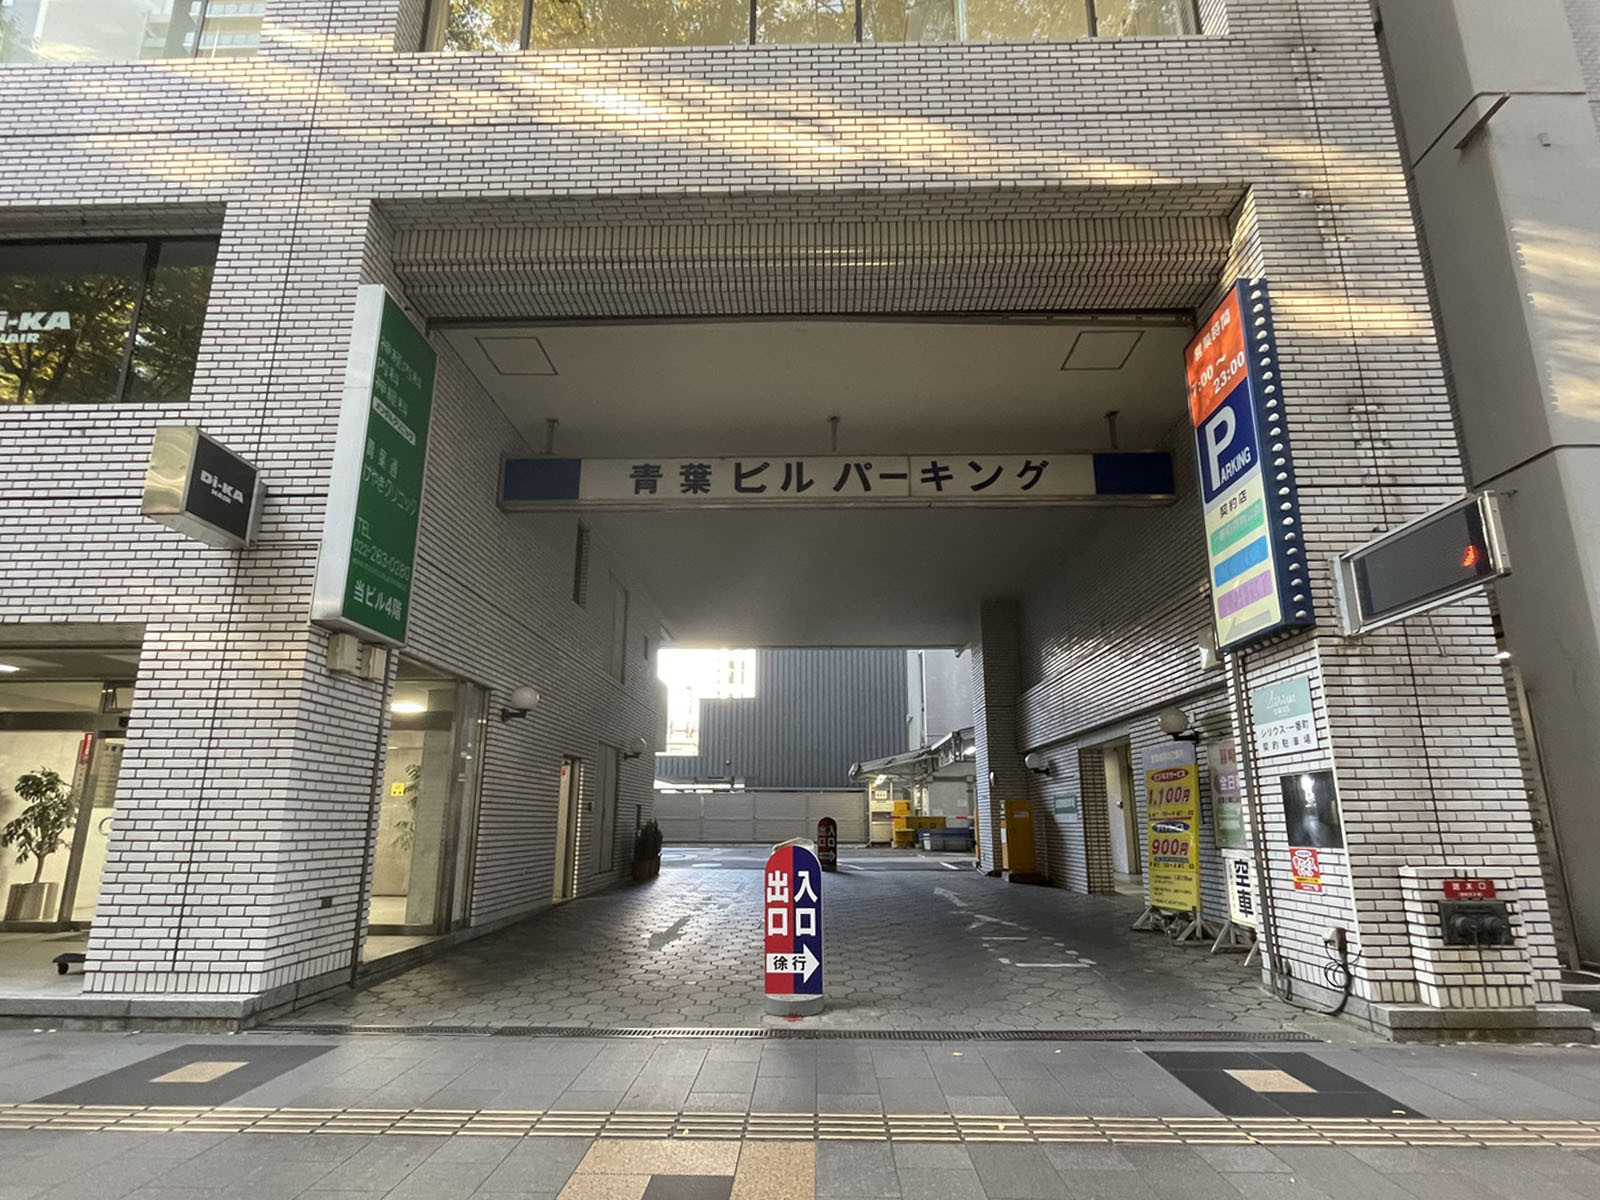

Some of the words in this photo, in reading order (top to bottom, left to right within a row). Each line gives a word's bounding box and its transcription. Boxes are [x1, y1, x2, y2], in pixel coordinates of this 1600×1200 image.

[1213, 351, 1245, 394] 23:00
[200, 470, 244, 504] Di-KA
[629, 460, 1049, 495] 青葉ビルパーキング
[357, 516, 372, 540] TEL
[353, 579, 403, 622] 当ビル4階
[1152, 838, 1188, 856] 900円
[766, 870, 789, 936] 出口
[794, 871, 818, 936] 入口
[1234, 859, 1254, 917] 空車
[773, 956, 807, 971] 徐行
